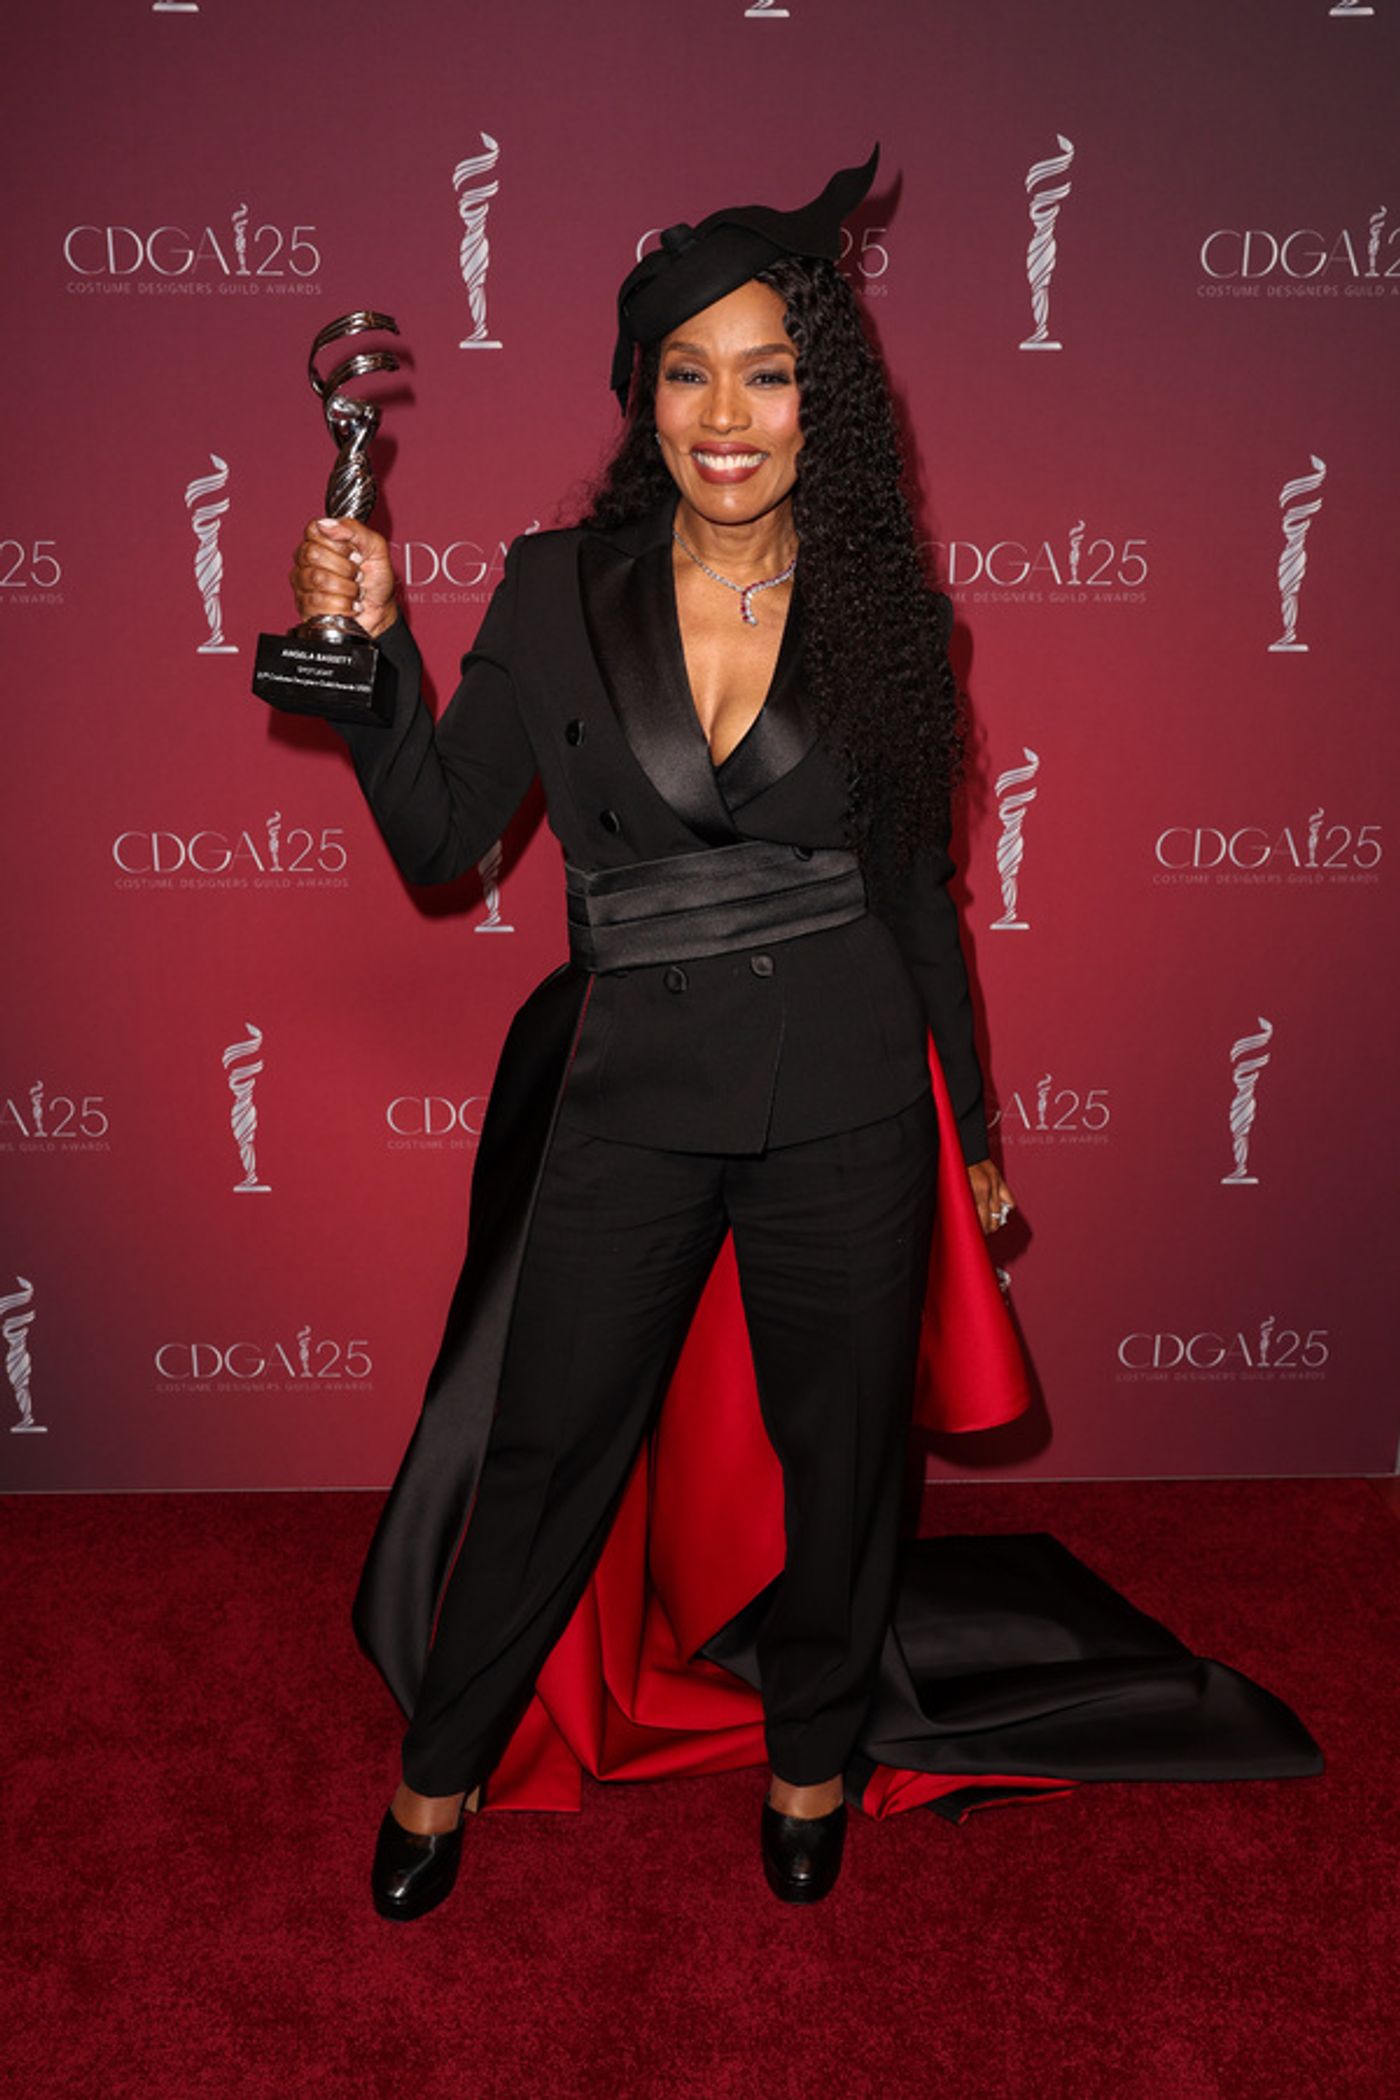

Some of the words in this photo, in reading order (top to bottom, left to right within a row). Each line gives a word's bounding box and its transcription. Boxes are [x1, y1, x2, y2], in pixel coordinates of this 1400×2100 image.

[66, 282, 131, 295] COSTUME
[138, 282, 212, 295] DESIGNERS
[219, 282, 259, 295] GUILD
[265, 282, 322, 295] AWARDS
[1197, 285, 1260, 297] COSTUME
[1267, 285, 1339, 297] DESIGNERS
[1344, 285, 1385, 297] GUILD
